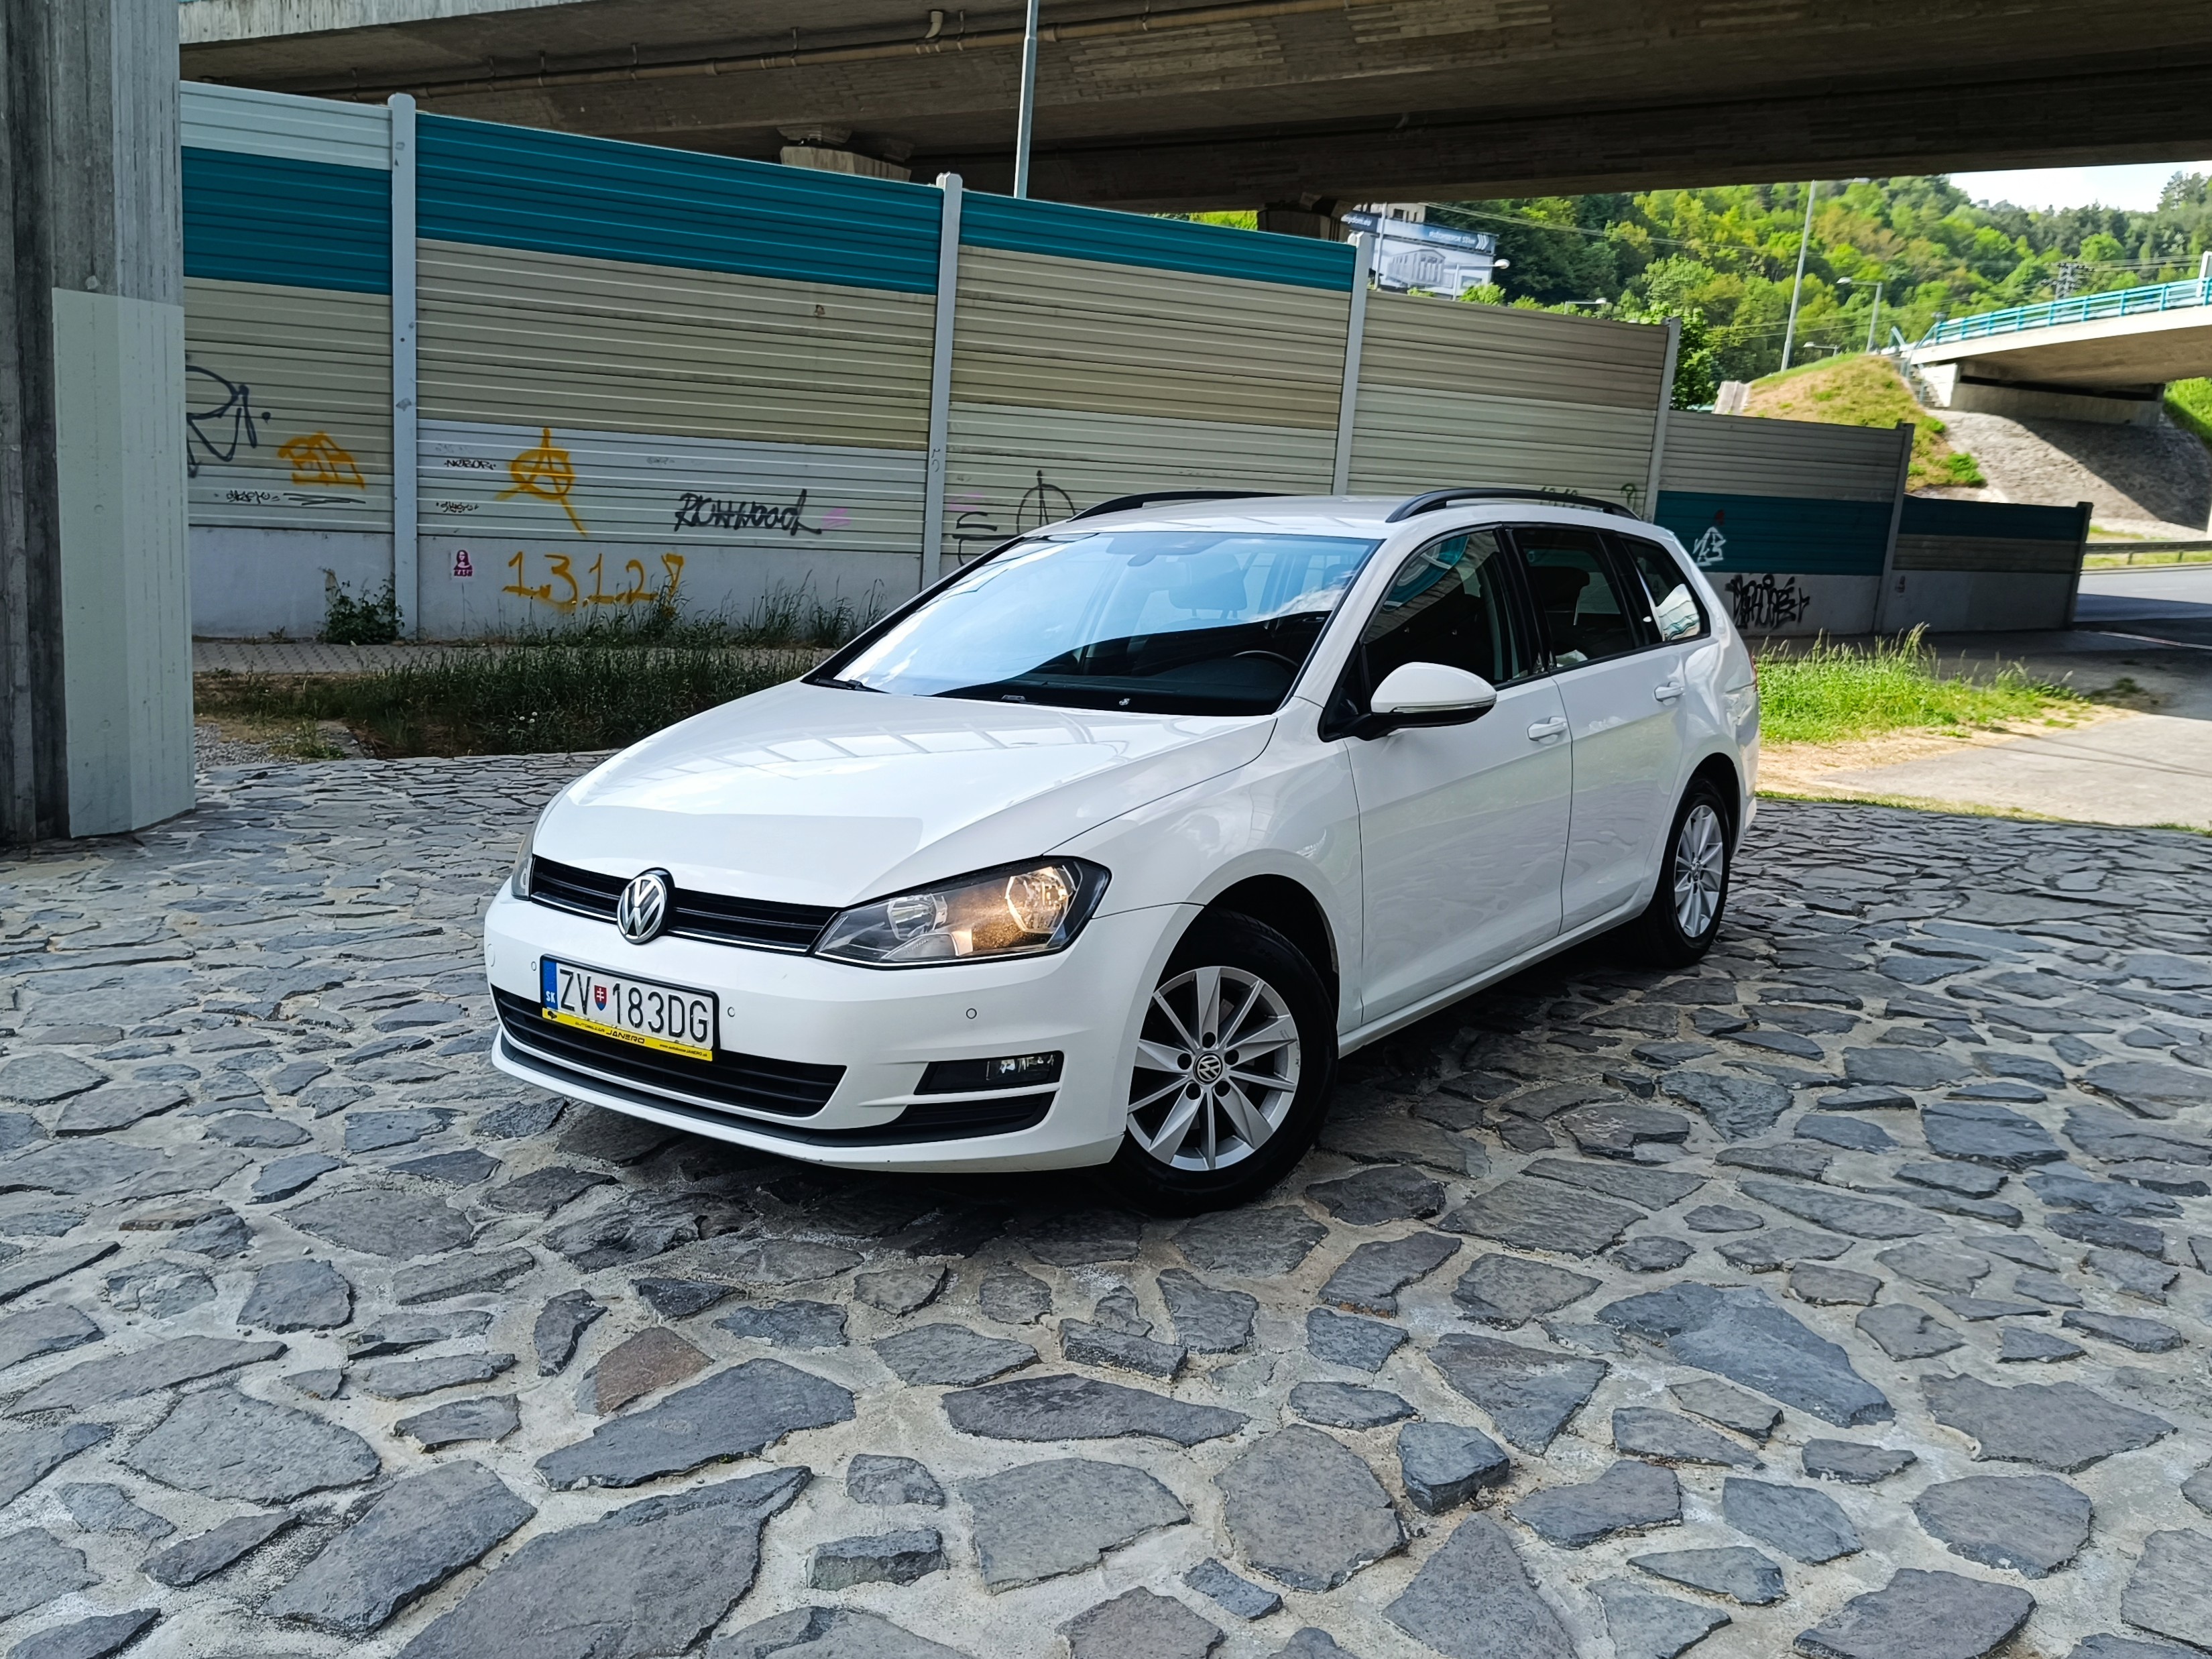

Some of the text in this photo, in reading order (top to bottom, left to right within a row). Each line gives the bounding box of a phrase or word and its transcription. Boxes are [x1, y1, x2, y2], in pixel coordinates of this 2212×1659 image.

[546, 990, 556, 1004] SK
[559, 968, 708, 1042] ZV 183DG
[606, 1030, 645, 1044] JANERO
